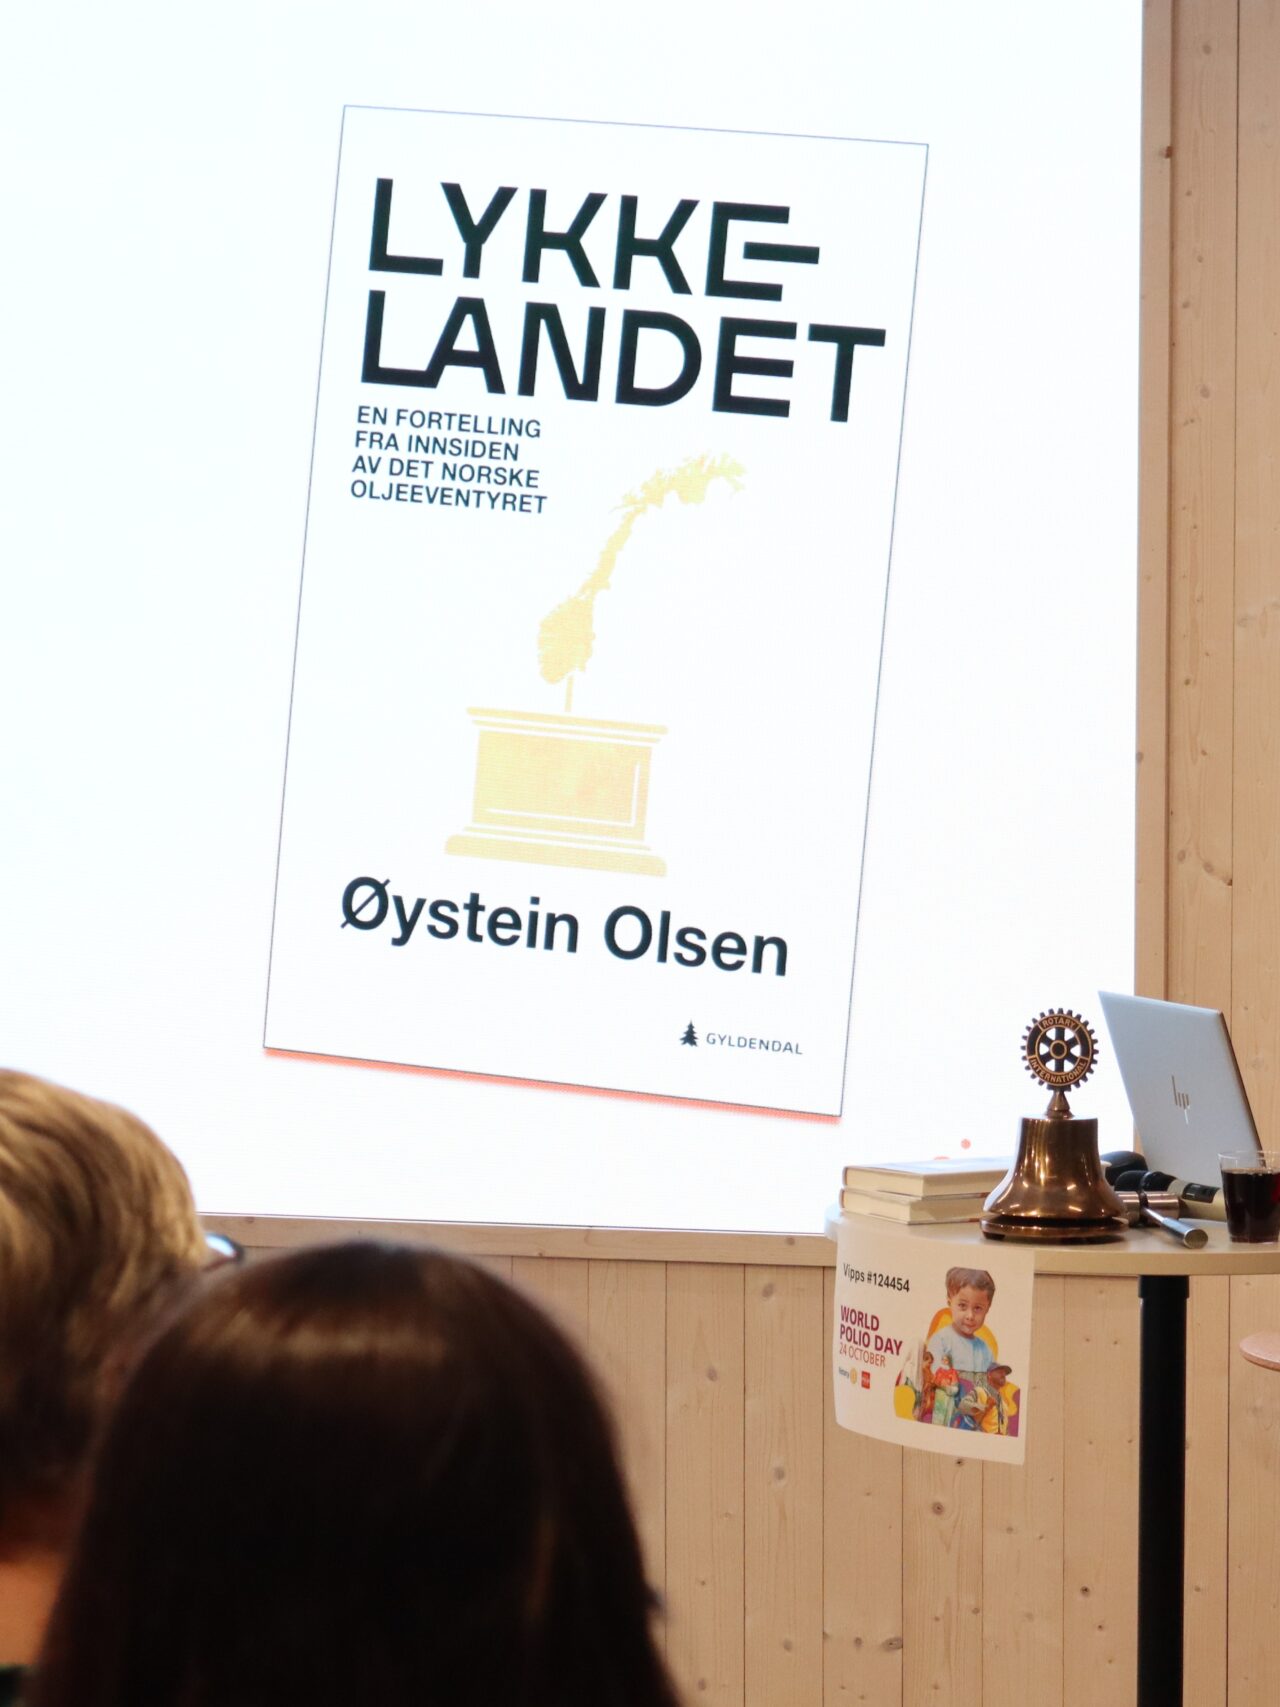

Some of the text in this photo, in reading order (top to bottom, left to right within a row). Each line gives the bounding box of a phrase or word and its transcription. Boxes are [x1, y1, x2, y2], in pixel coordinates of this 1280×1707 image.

[369, 177, 820, 302] LYKKE
[361, 289, 887, 423] LANDET
[357, 405, 542, 439] EN FORTELLING
[355, 430, 520, 462] FRA INNSIDEN
[351, 455, 541, 489] AV DET NORSKE
[350, 479, 548, 514] OLJEEVENTYRET
[341, 876, 788, 977] Øystein Olsen
[1042, 1016, 1076, 1028] ROTARY
[706, 1032, 803, 1055] GYLDENDAL
[1030, 1059, 1087, 1083] INTERNATIONAL
[843, 1262, 910, 1293] Vipps #124454
[841, 1305, 880, 1331] WORLD
[839, 1343, 886, 1368] 24 OCTOBER
[840, 1325, 903, 1356] POLIO DAY
